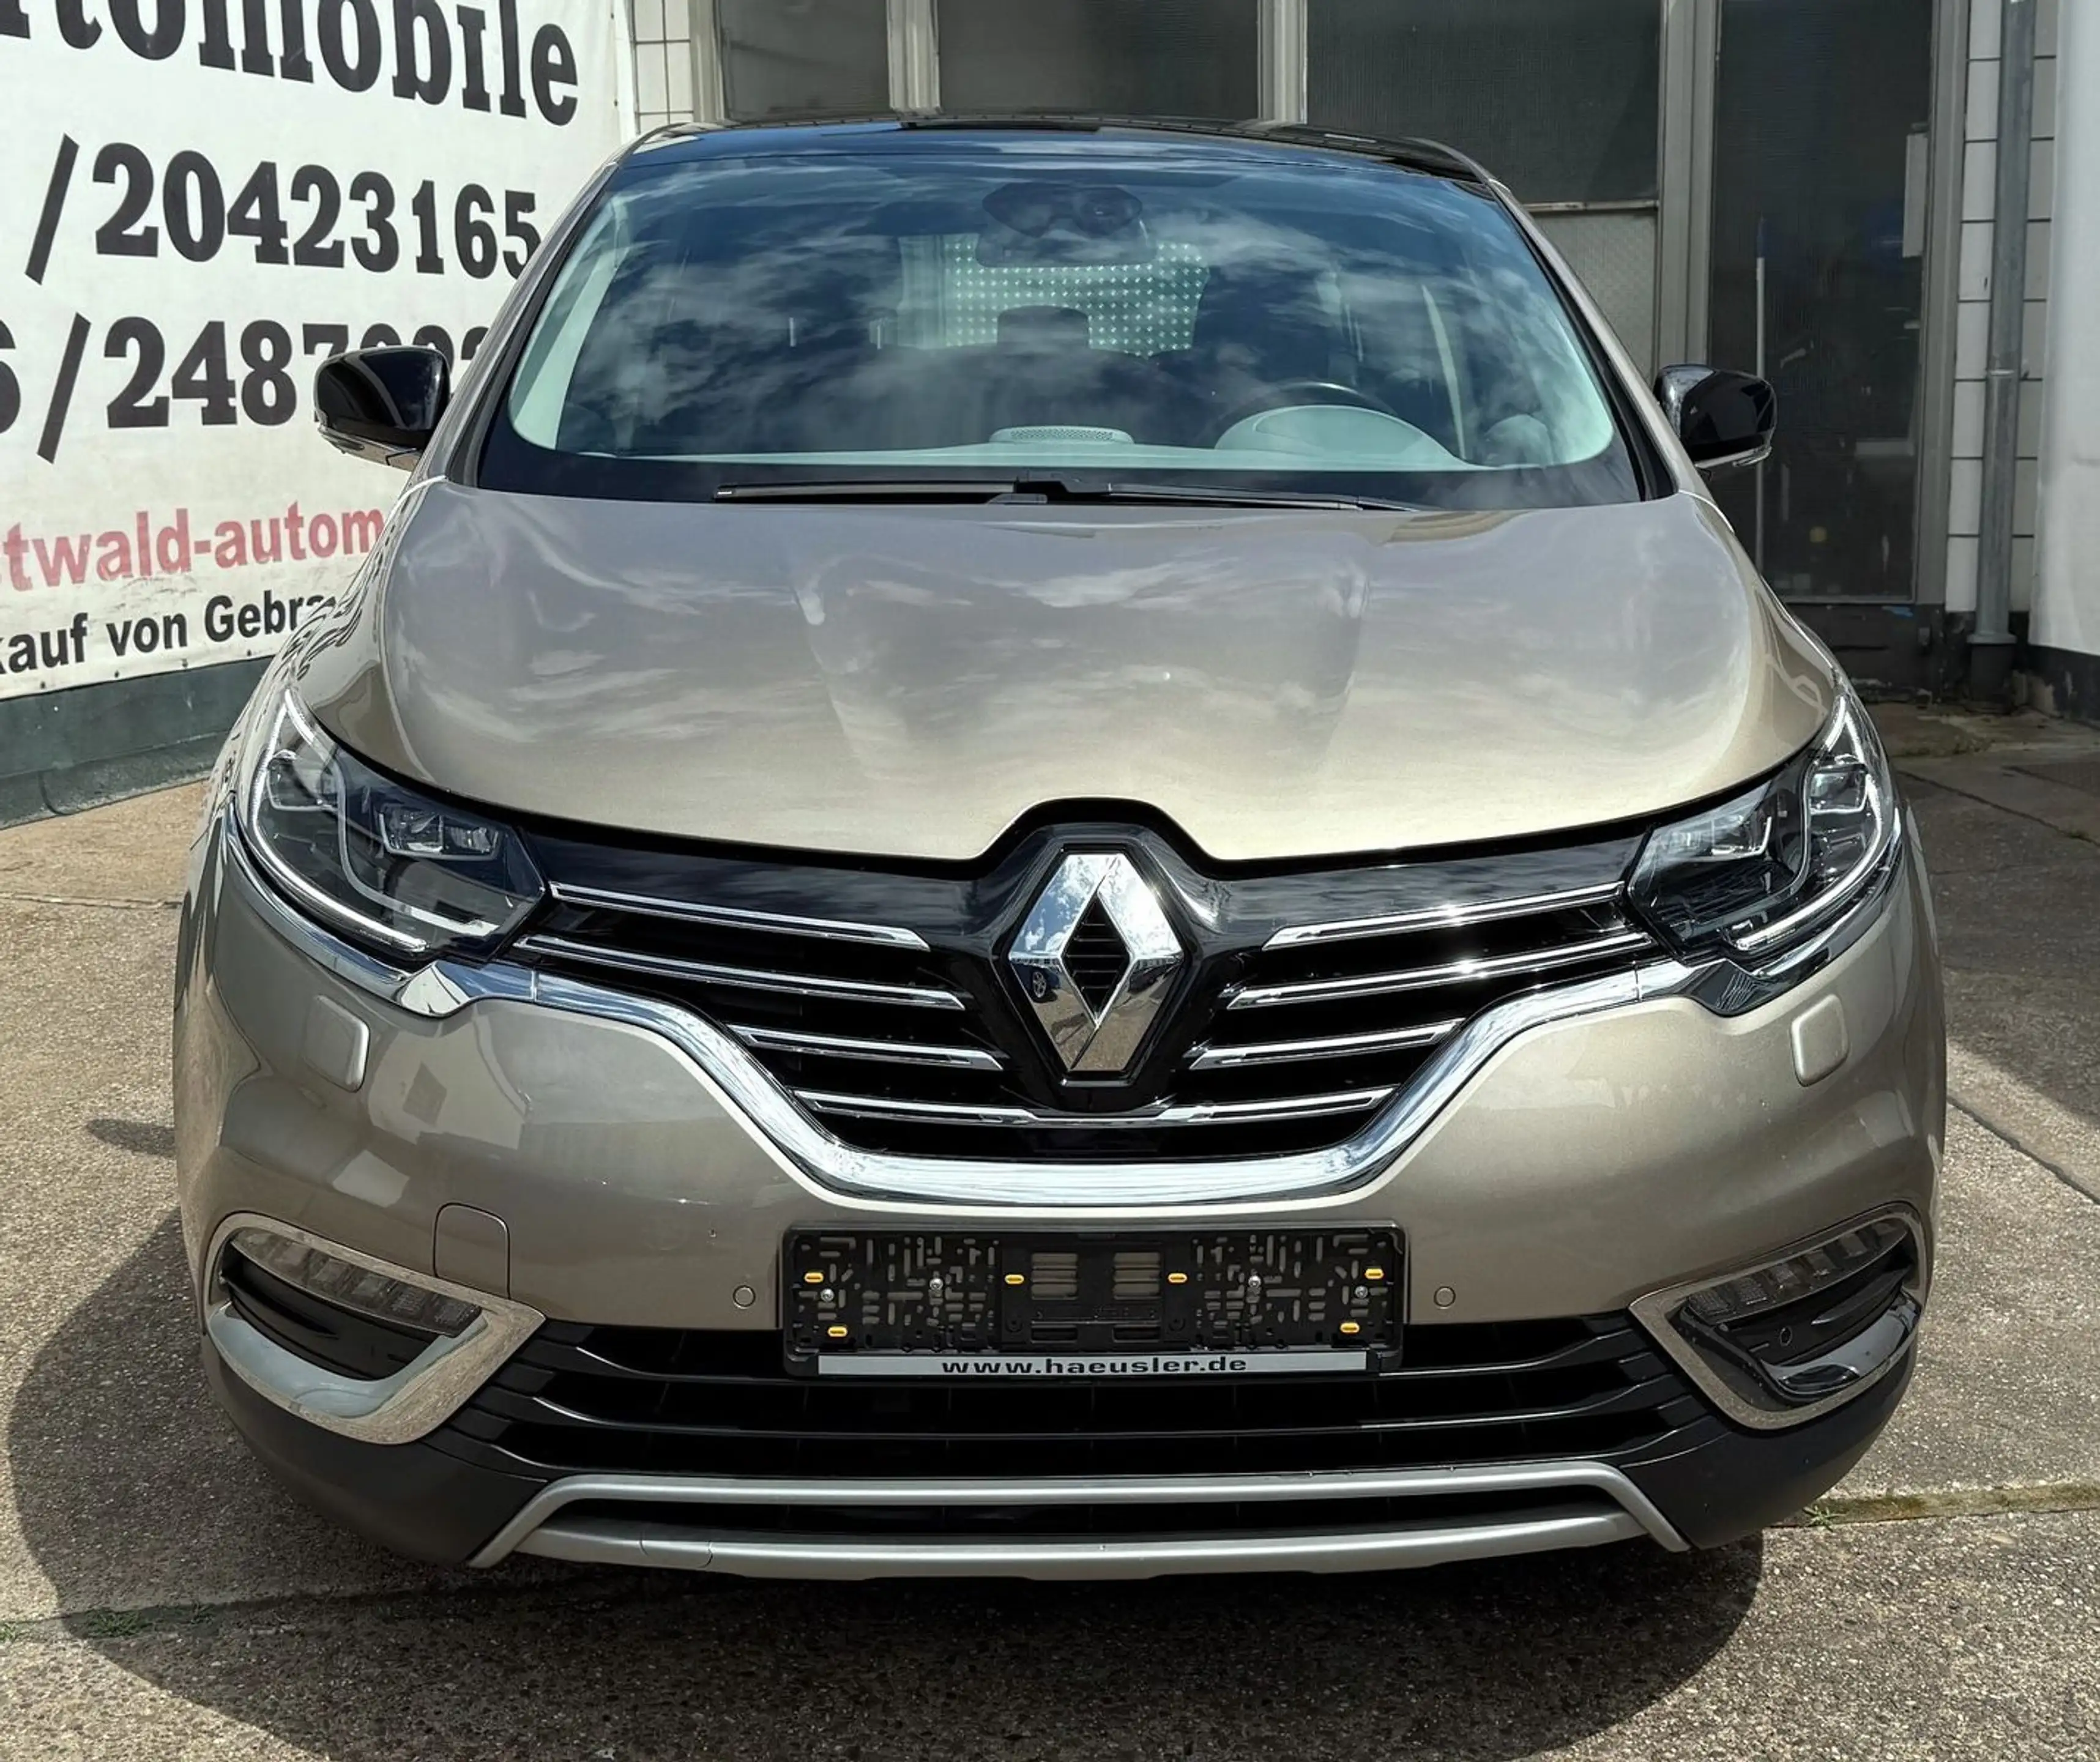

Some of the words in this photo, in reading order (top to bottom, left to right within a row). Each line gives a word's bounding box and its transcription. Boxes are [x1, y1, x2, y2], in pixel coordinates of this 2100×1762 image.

[0, 0, 578, 126] mobile
[0, 501, 384, 592] twald-autom
[0, 612, 88, 674] auf
[106, 614, 187, 656] von
[204, 590, 324, 642] Gebr
[942, 1356, 1246, 1374] www.haeusler.de
